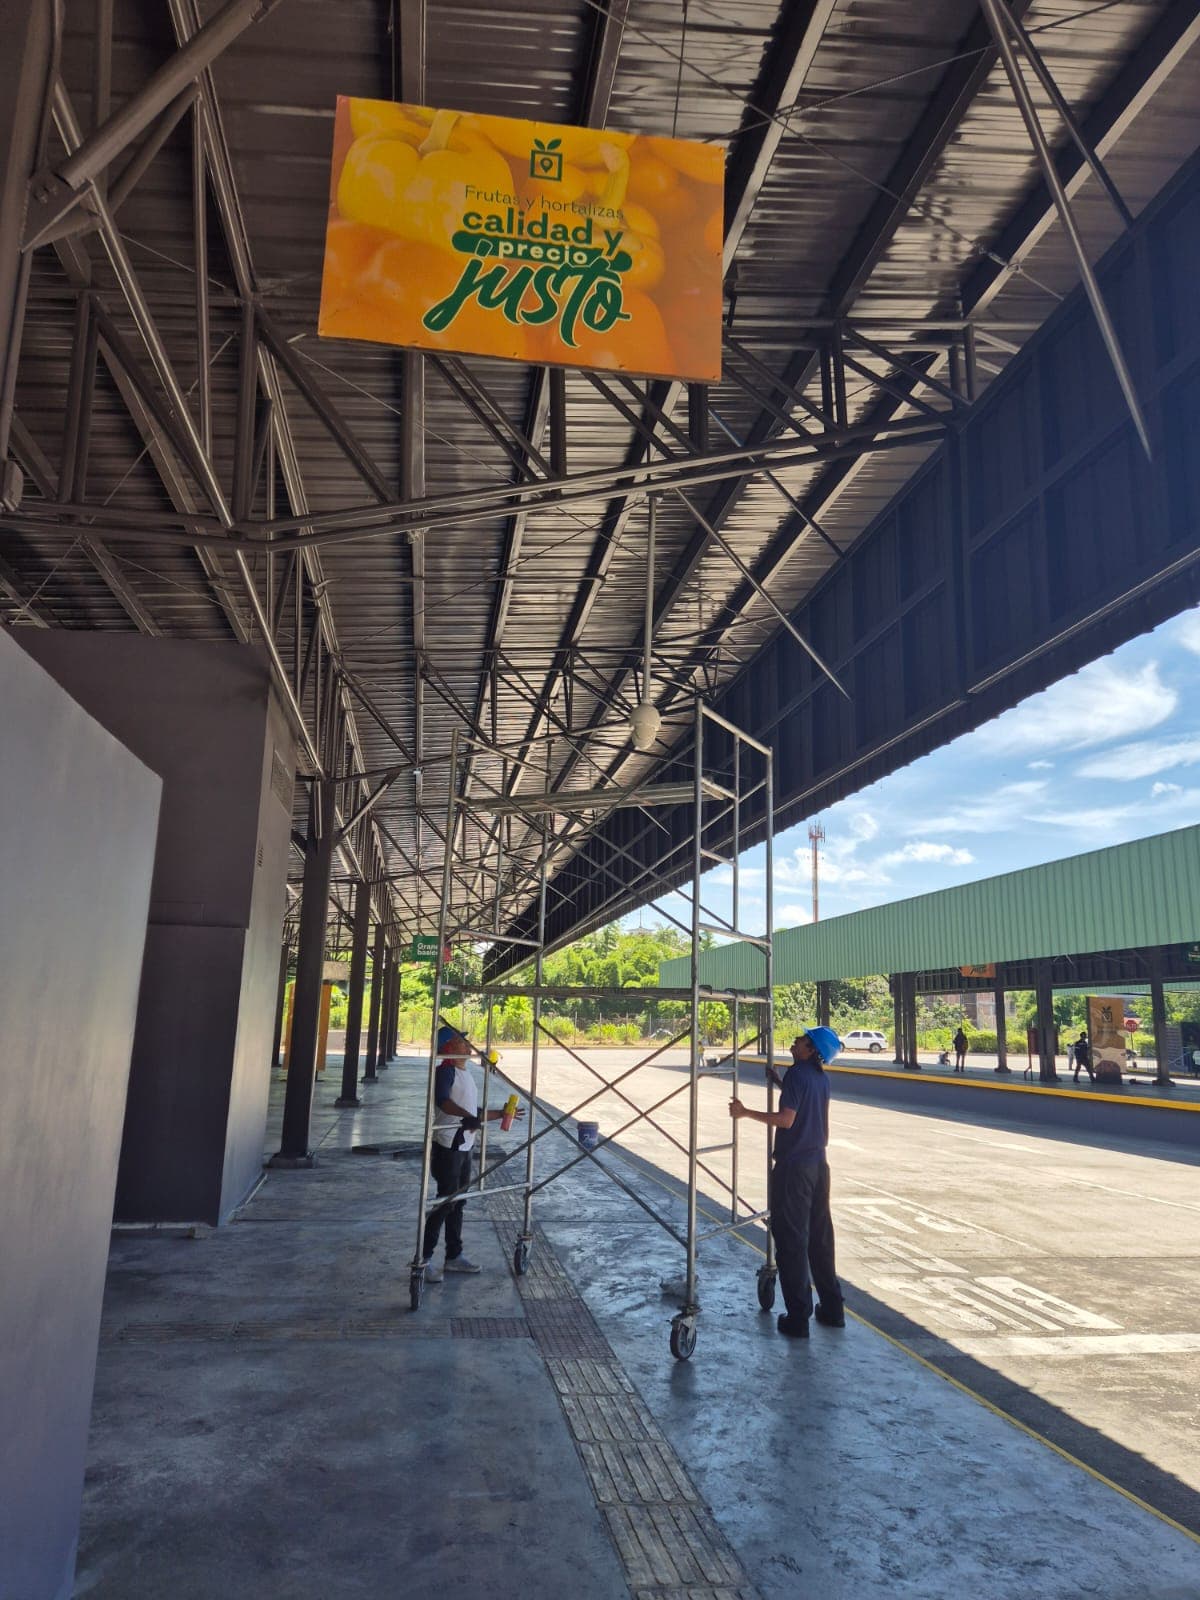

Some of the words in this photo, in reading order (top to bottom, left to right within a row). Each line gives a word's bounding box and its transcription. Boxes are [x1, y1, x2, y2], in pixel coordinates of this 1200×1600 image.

[465, 185, 520, 206] Frutas
[526, 197, 535, 210] y
[541, 195, 624, 219] hortalizas
[463, 207, 593, 244] calidad
[604, 230, 624, 256] y
[498, 240, 588, 265] precio
[422, 239, 632, 348] justo
